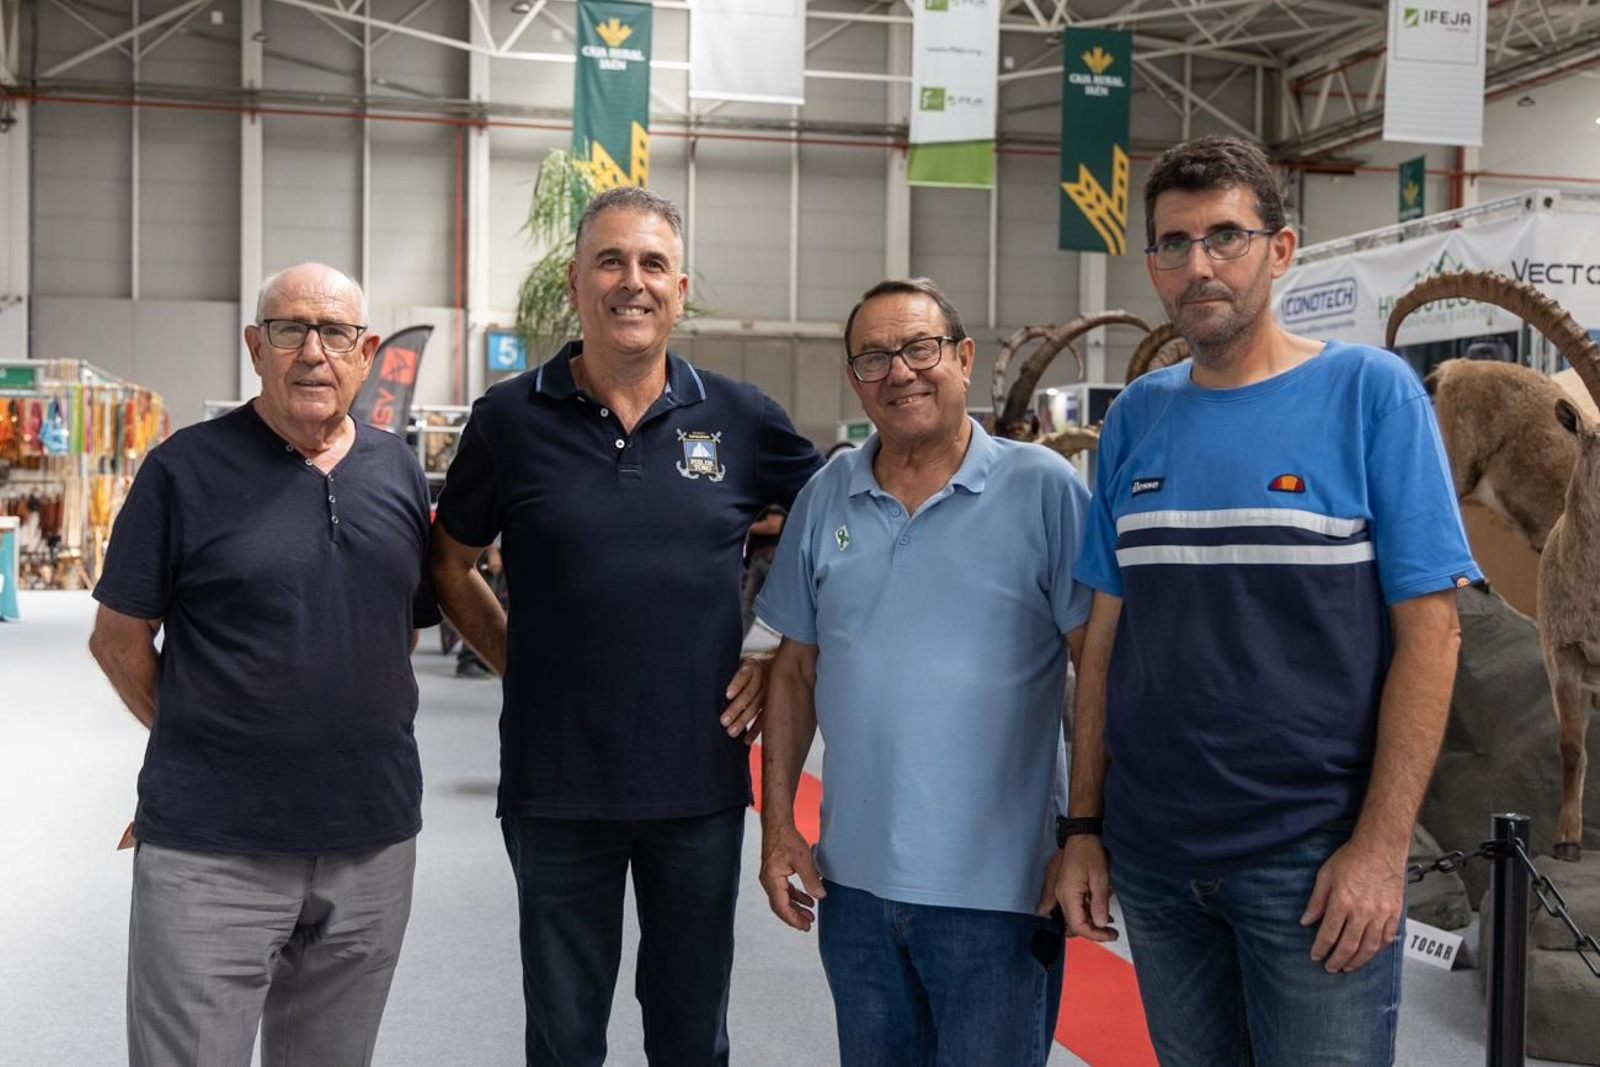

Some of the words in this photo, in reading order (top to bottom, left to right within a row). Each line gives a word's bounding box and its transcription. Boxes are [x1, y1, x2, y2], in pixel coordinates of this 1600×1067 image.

[1424, 9, 1472, 26] IFEJA
[1286, 286, 1354, 317] CONOTECH
[497, 336, 518, 365] 5
[1410, 934, 1454, 961] TOCAR
